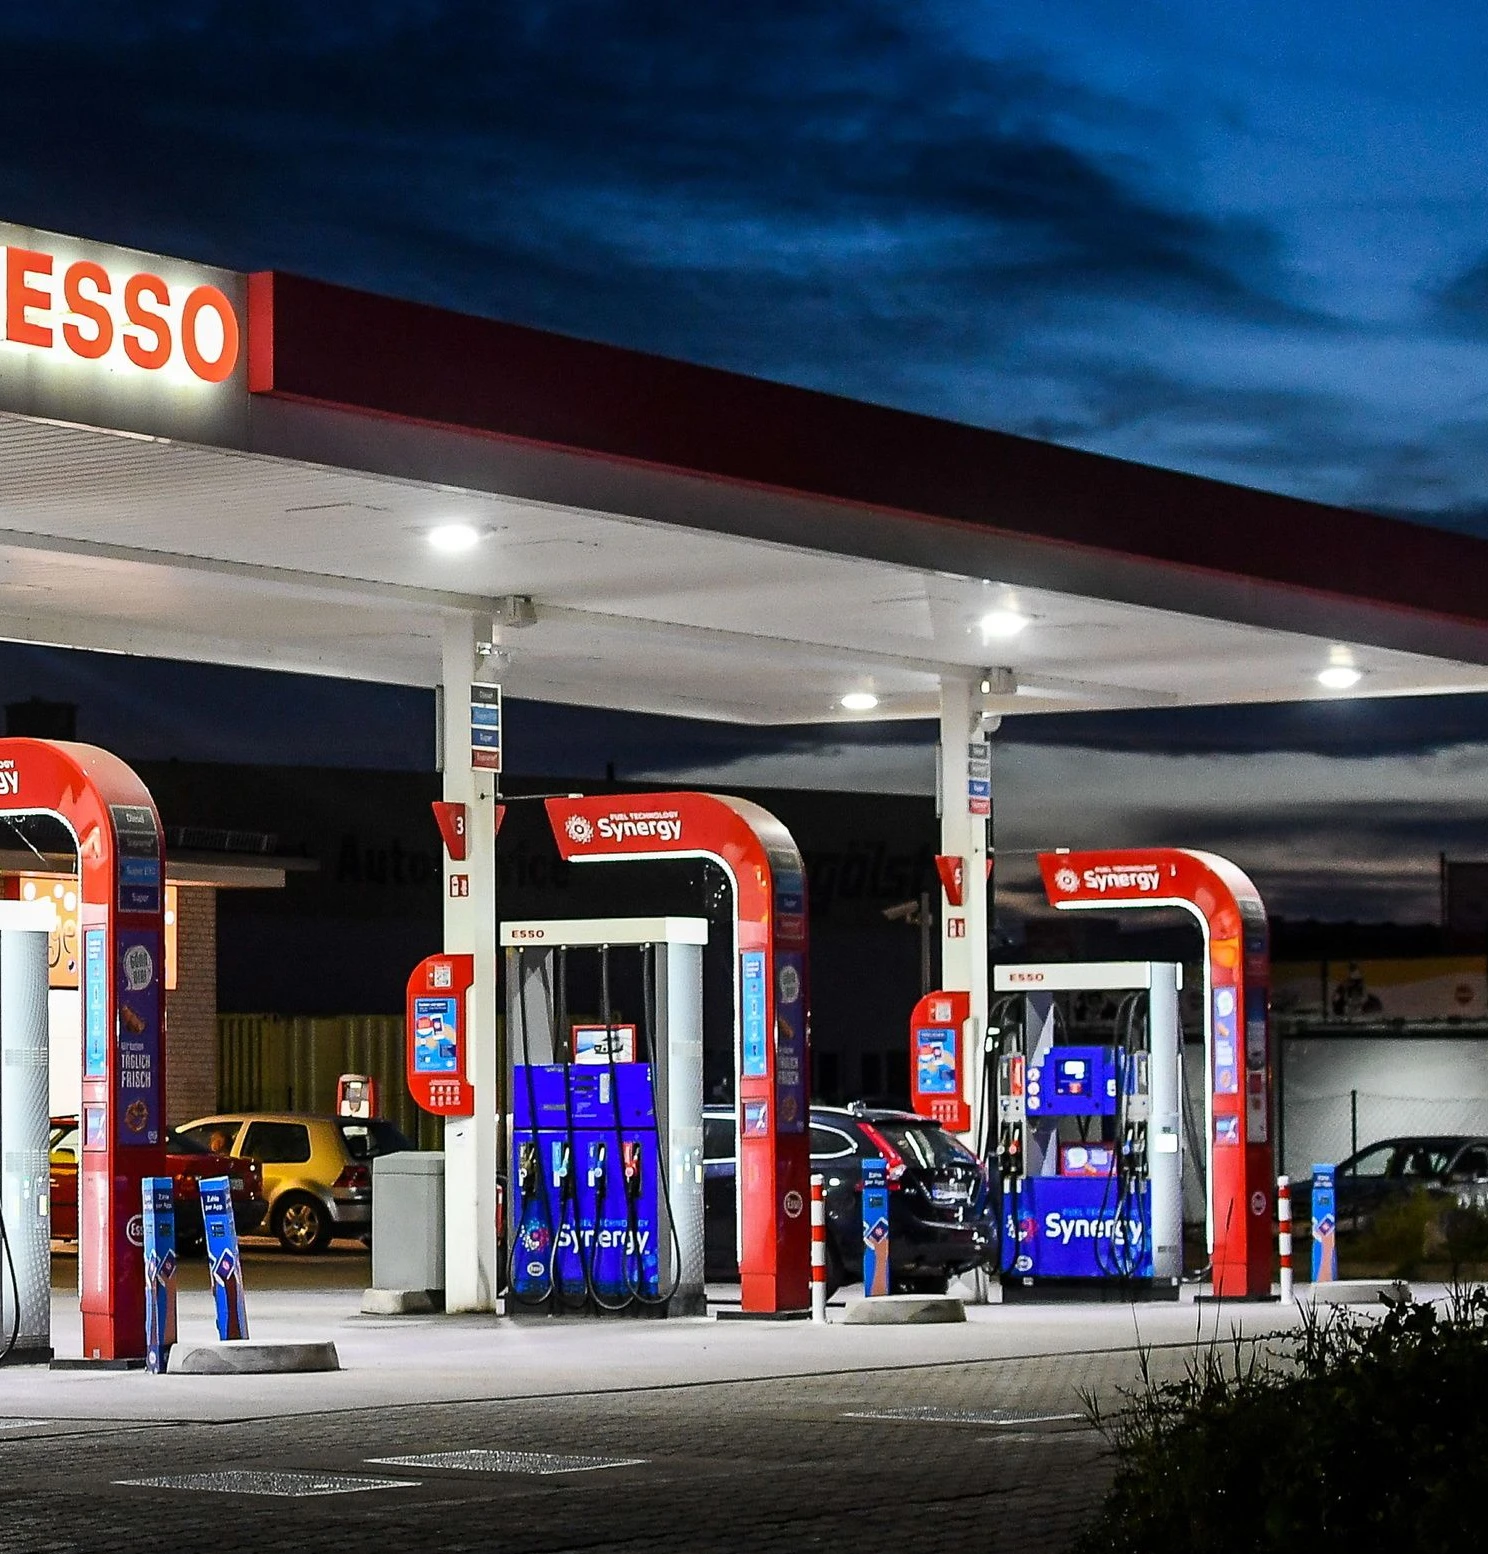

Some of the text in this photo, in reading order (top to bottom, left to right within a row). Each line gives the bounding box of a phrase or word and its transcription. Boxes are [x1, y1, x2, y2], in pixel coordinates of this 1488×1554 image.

[5, 245, 239, 383] ESSO
[456, 816, 464, 835] 3
[597, 818, 681, 842] Synergy
[1083, 870, 1160, 892] Synergy
[511, 929, 545, 938] ESSO
[1009, 972, 1044, 982] ESSO
[121, 1070, 151, 1089] FRISCH
